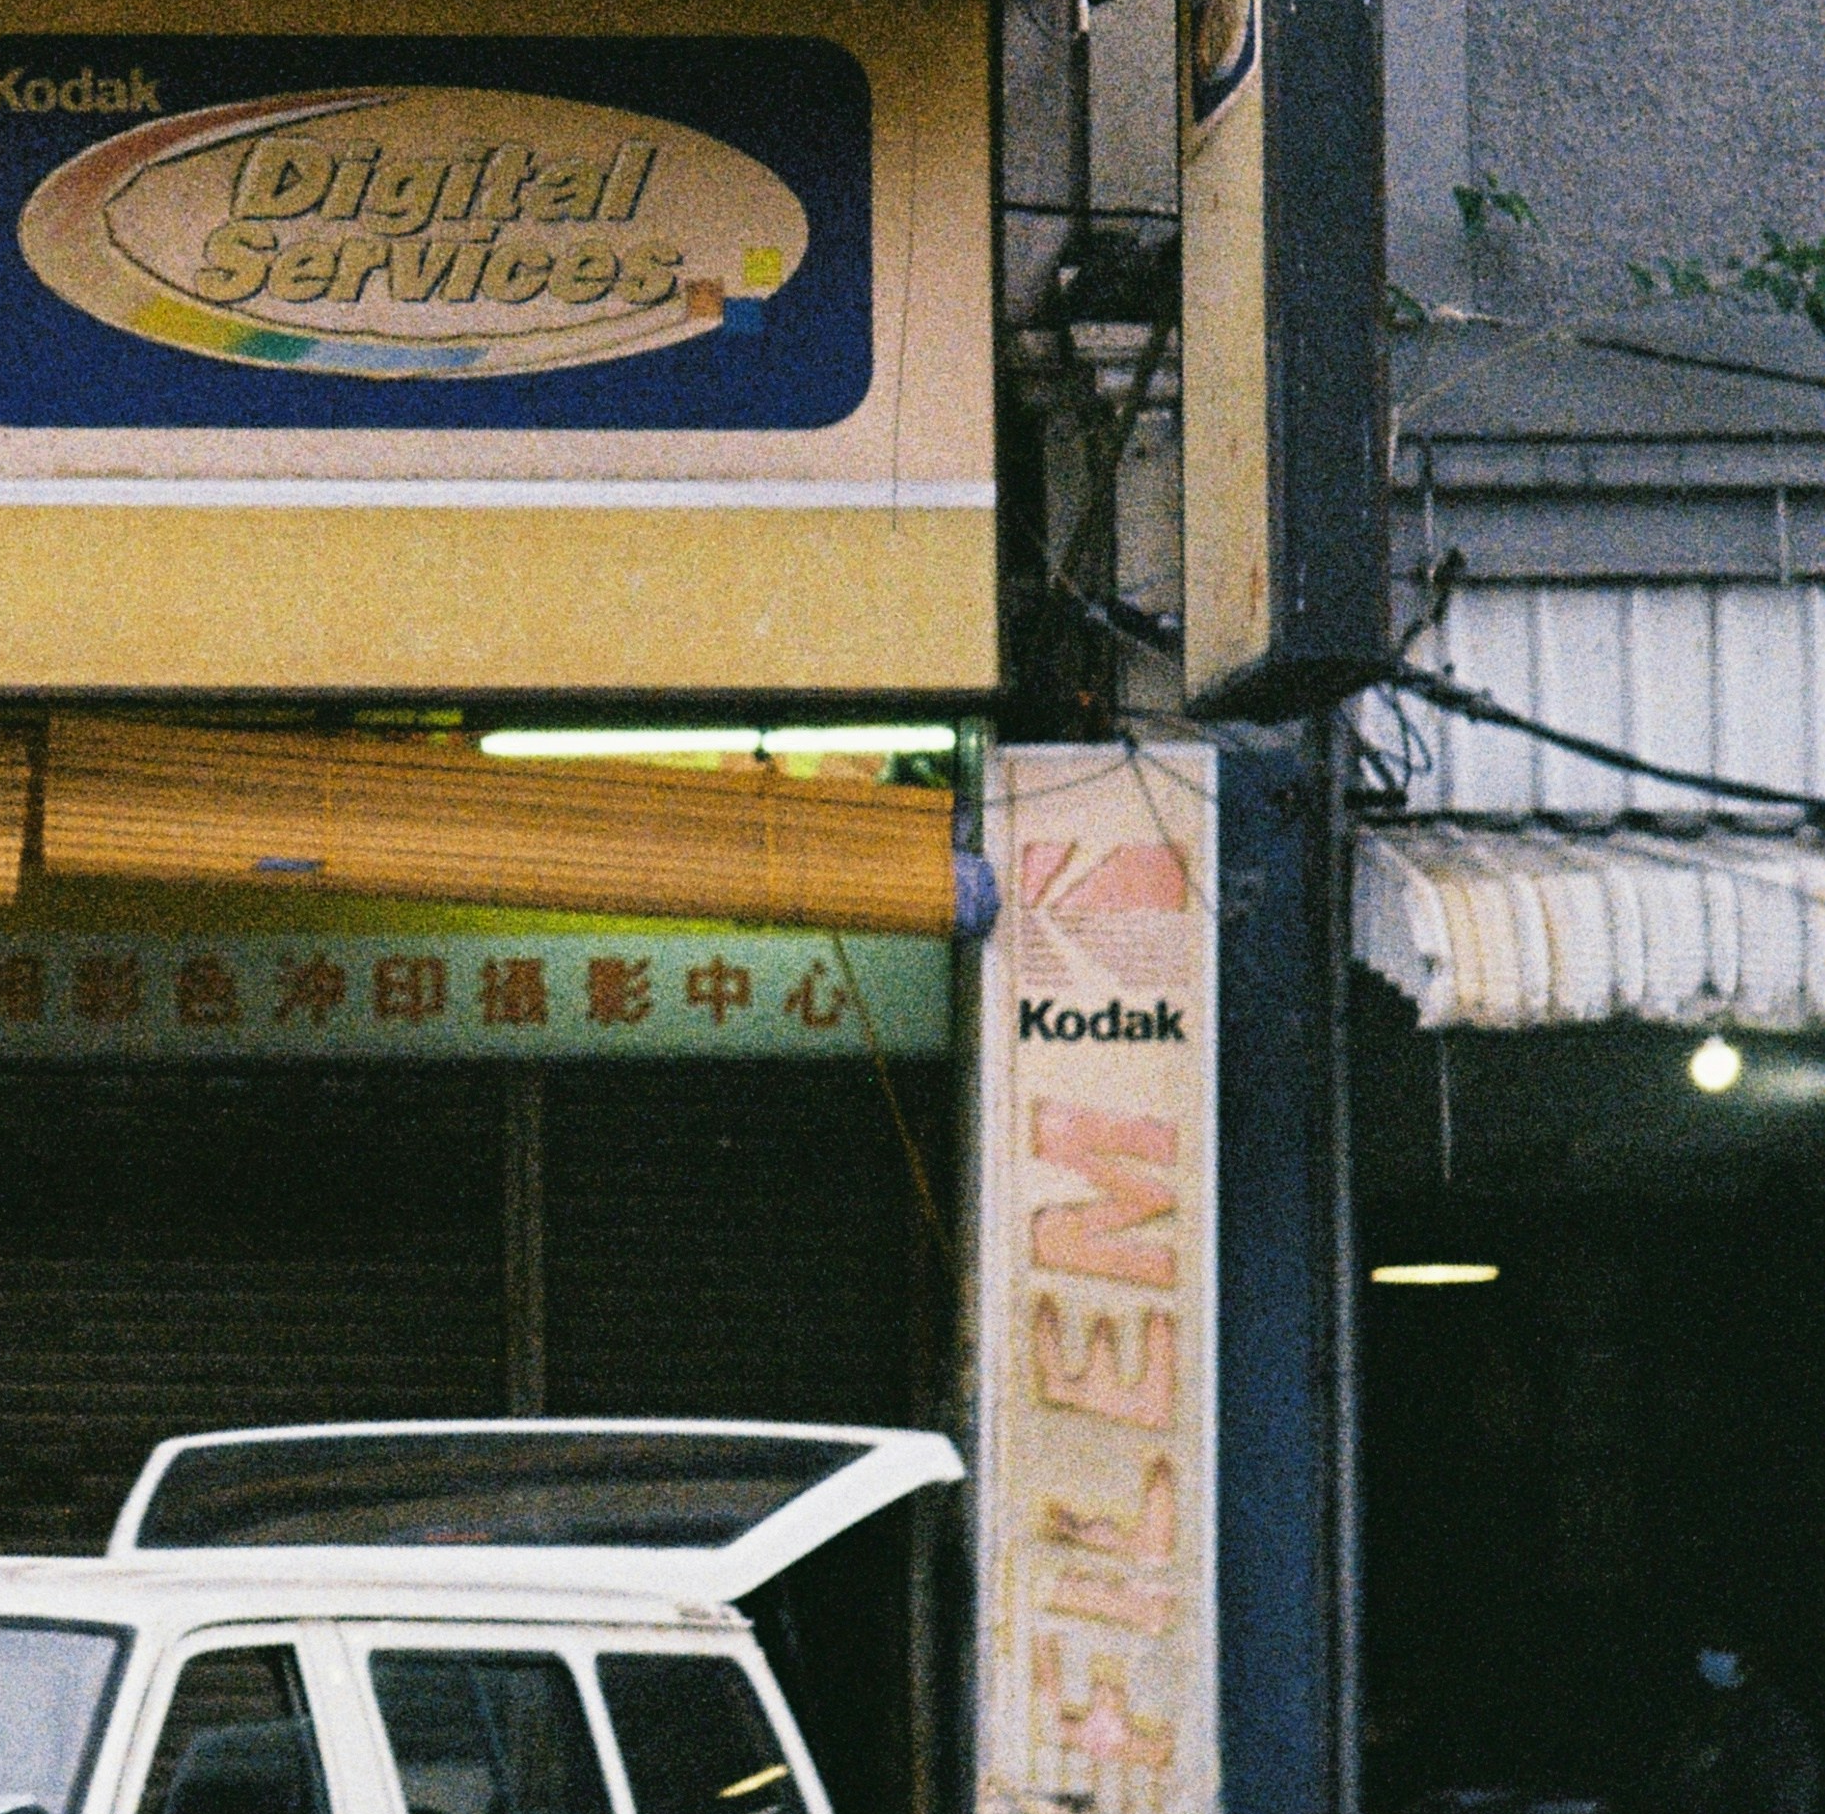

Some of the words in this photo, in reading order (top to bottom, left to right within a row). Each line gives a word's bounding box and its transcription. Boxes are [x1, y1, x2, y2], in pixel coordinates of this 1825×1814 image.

[234, 134, 660, 237] Digital
[192, 219, 691, 308] Services
[1019, 998, 1186, 1043] Kodak
